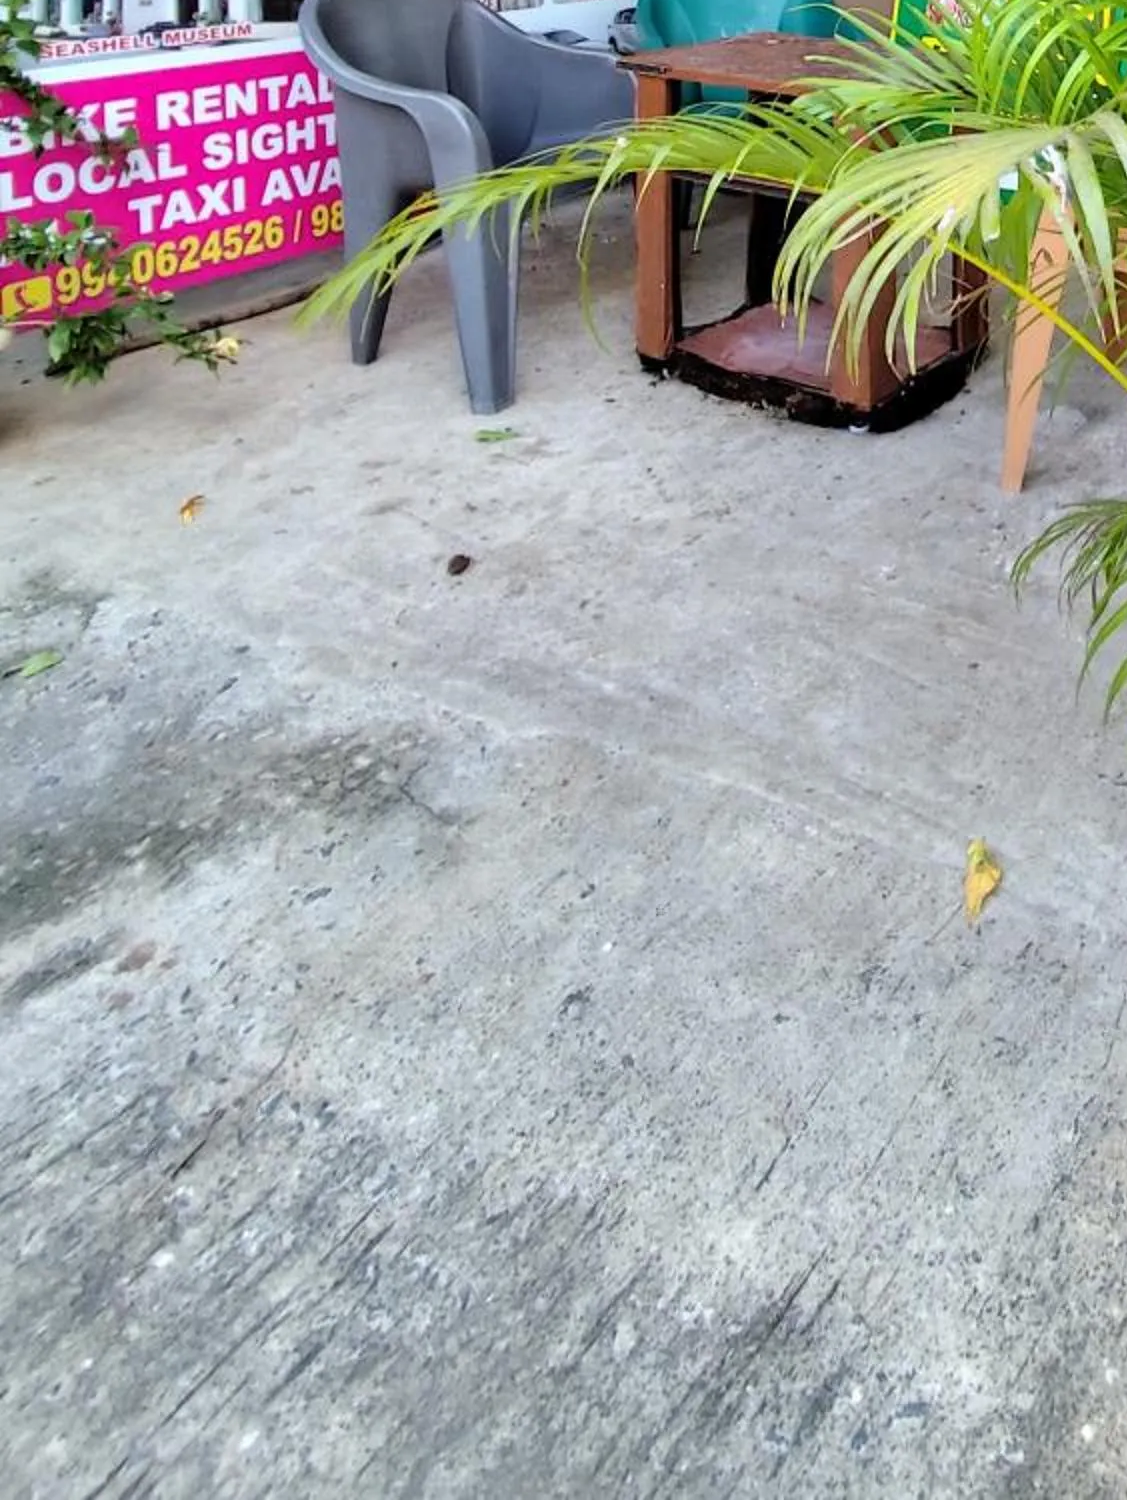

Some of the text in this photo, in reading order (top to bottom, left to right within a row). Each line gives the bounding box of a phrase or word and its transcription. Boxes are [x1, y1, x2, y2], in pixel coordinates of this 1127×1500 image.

[40, 23, 254, 58] SEASHELL MUSEUM
[0, 143, 187, 212] LOCAL
[129, 177, 245, 235] TAXI
